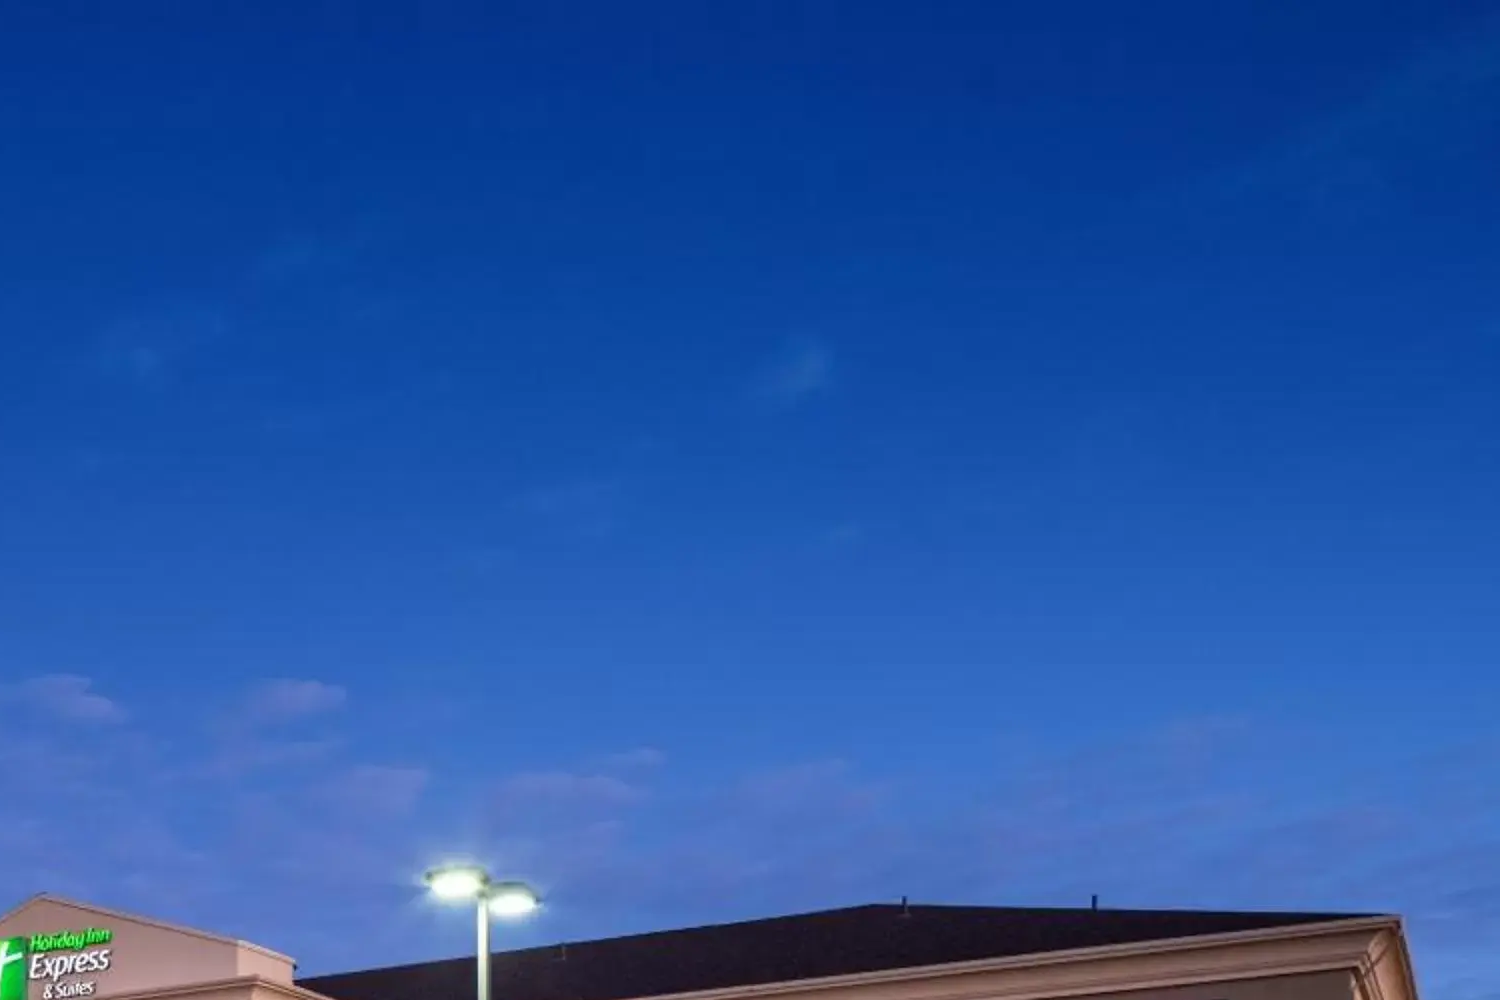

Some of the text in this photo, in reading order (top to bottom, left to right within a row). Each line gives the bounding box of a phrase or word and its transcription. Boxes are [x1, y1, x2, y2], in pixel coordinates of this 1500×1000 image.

[30, 928, 110, 951] Holiday Inn
[29, 949, 110, 982] Express
[43, 982, 94, 999] & Suites
